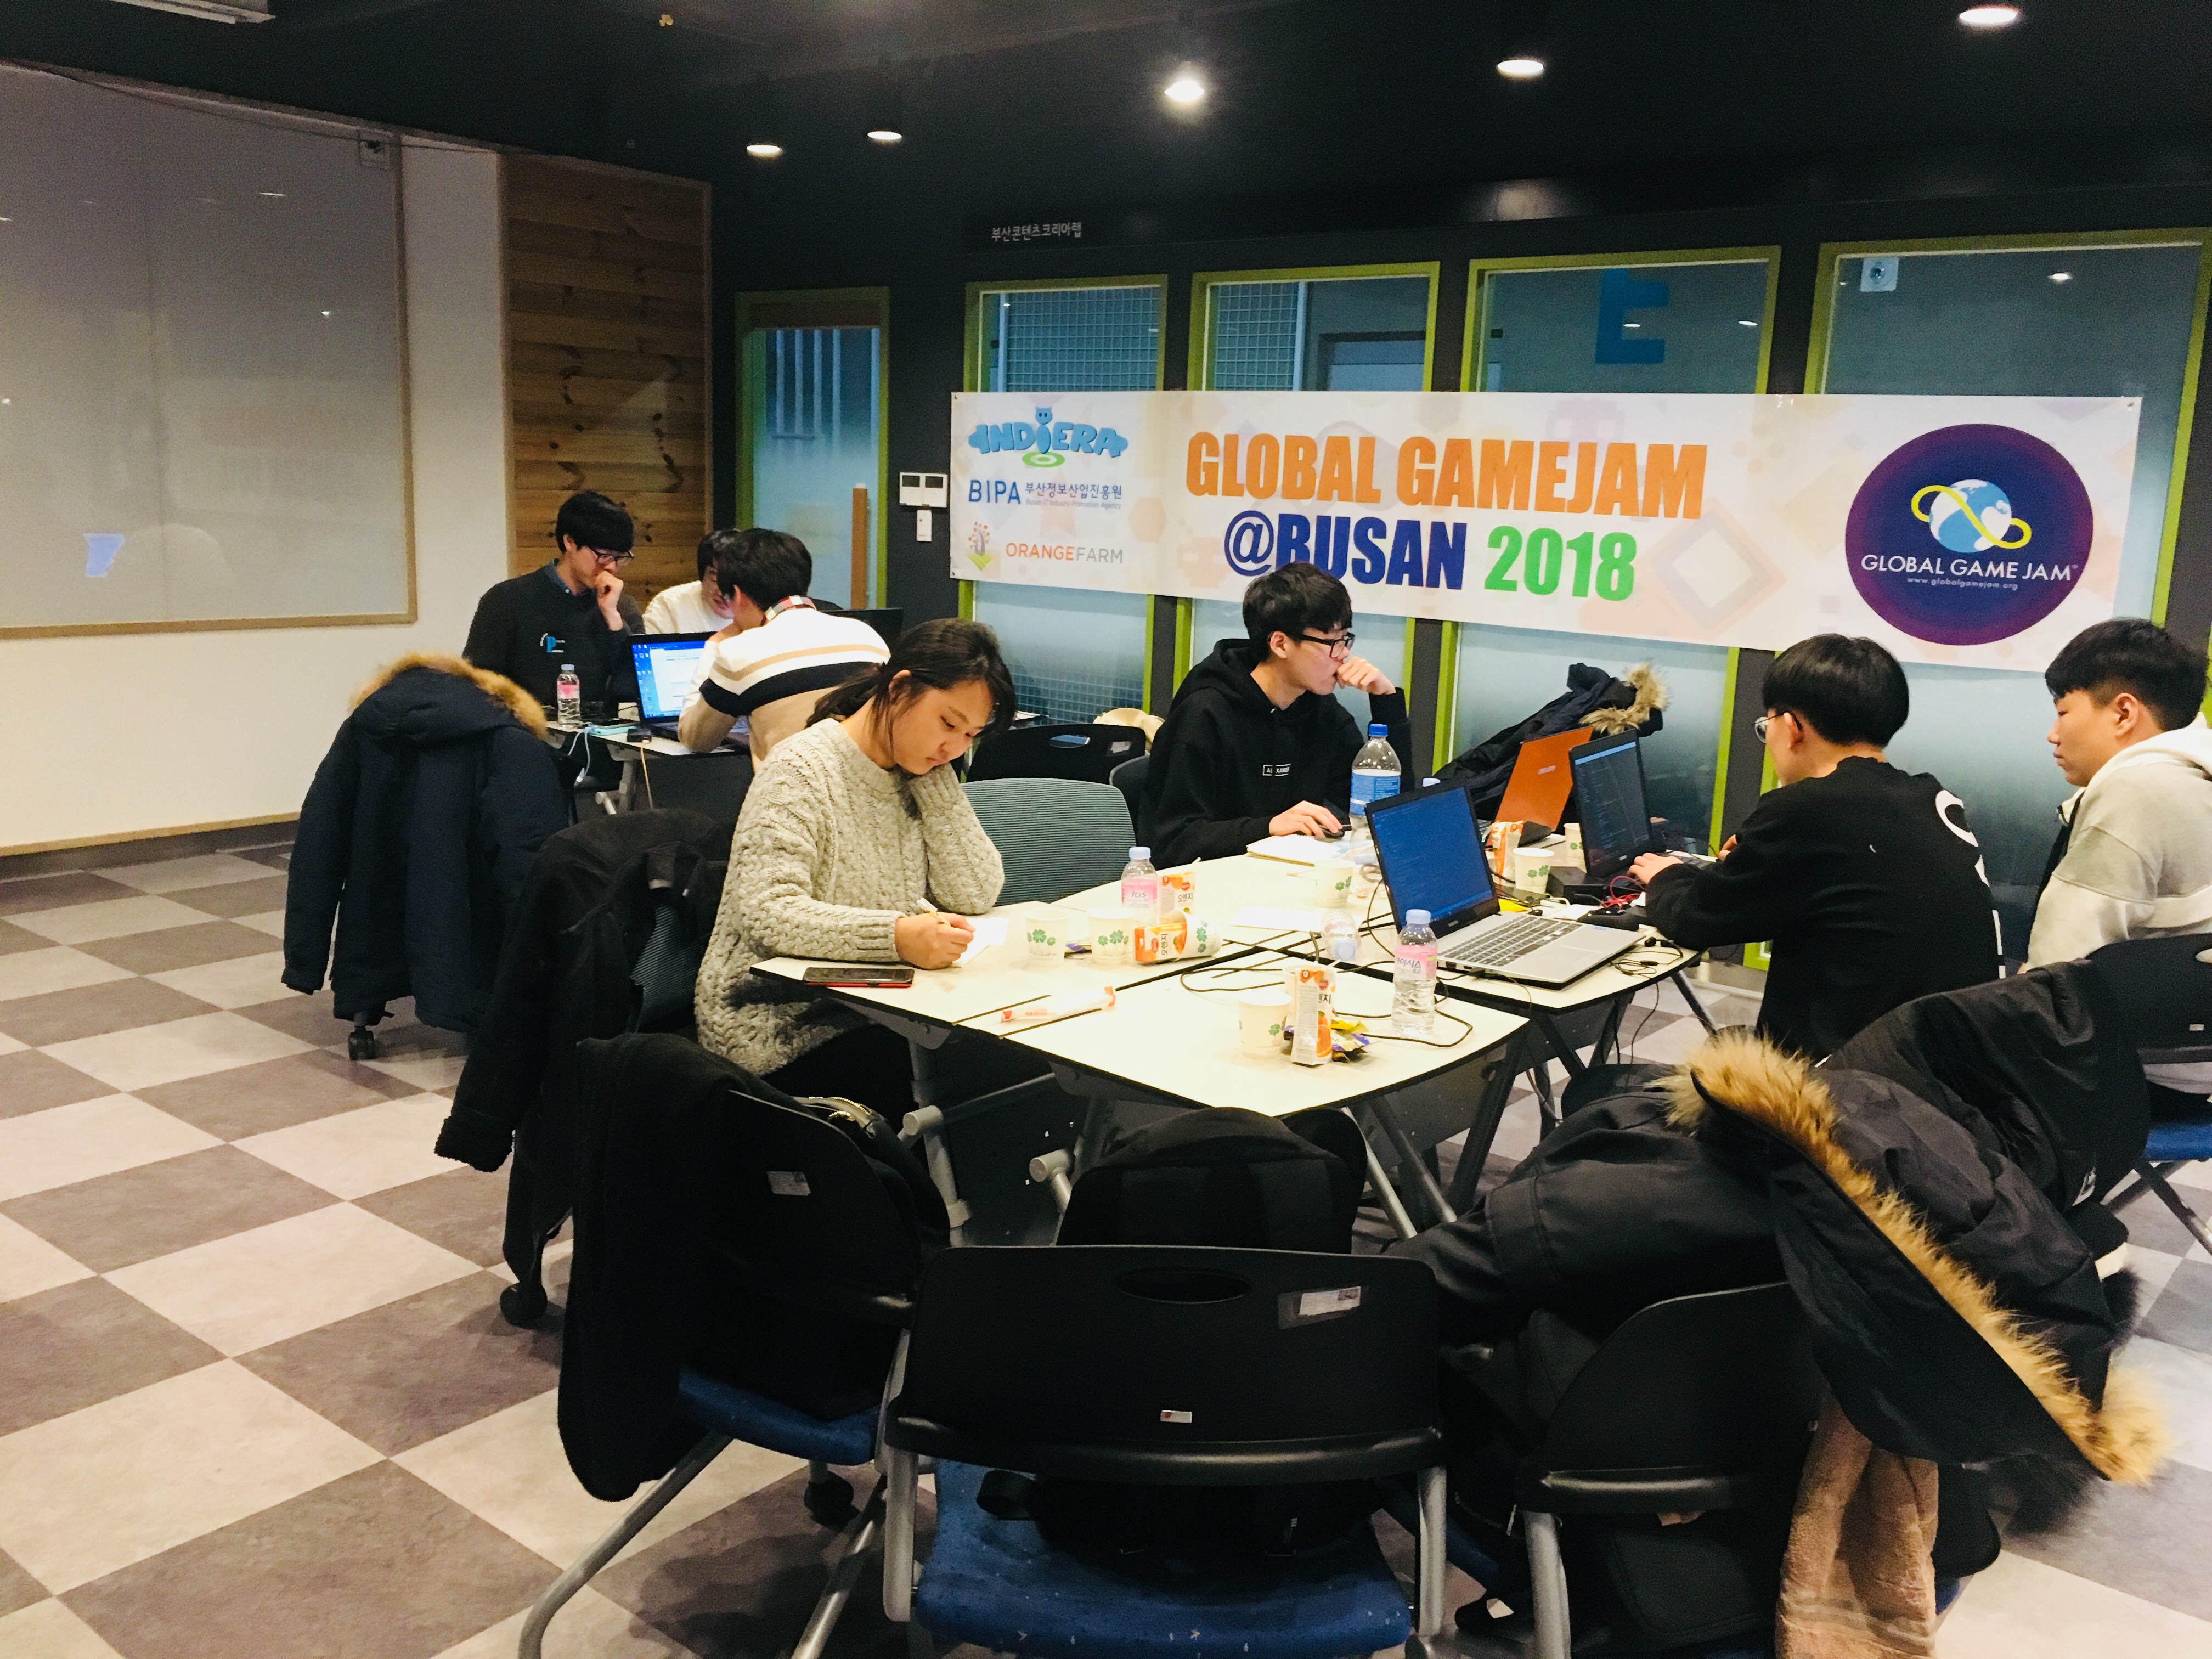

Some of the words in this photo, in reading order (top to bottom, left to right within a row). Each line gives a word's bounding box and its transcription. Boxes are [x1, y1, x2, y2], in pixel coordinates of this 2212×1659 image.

[991, 221, 1081, 242] 부산콘텐츠코리아랩
[1187, 432, 1383, 504] GLOBAL
[1397, 436, 1708, 520] GAMEJAM
[968, 479, 1021, 504] BIPA
[1025, 482, 1122, 500] 부산정보산업진흥원
[1224, 510, 1467, 590] @BUSAN
[1485, 526, 1637, 601] 2018
[1861, 554, 1944, 575] GLOBAL
[1950, 558, 2017, 579] GAME
[2022, 563, 2072, 581] JAM
[1907, 578, 2018, 591] www.globalgamejam.org
[1177, 893, 1193, 902] 오렌지
